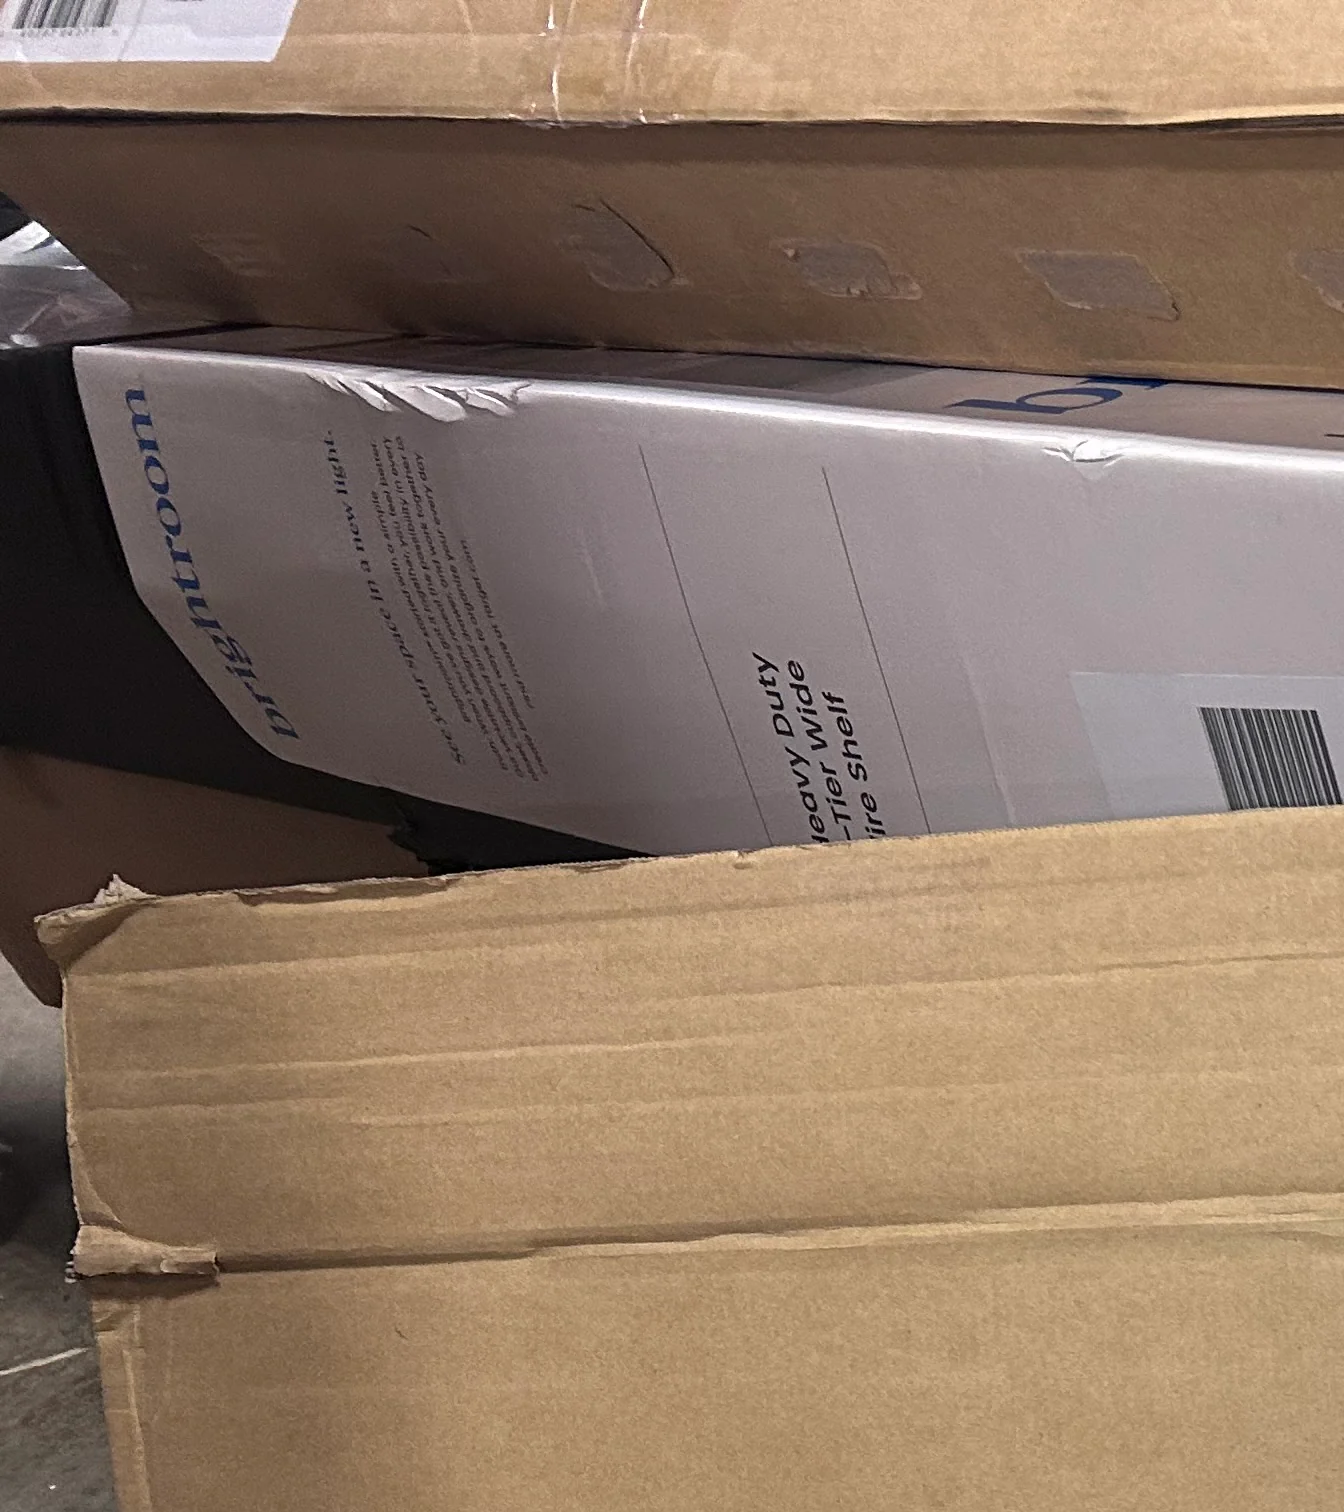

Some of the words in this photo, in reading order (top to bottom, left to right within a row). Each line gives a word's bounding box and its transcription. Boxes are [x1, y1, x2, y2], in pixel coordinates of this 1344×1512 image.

[322, 429, 348, 495] light.
[125, 386, 299, 740] brightroom
[752, 652, 795, 737] Duty
[787, 660, 828, 751] Wide
[821, 691, 868, 782] Shelf
[860, 792, 886, 839] ire
